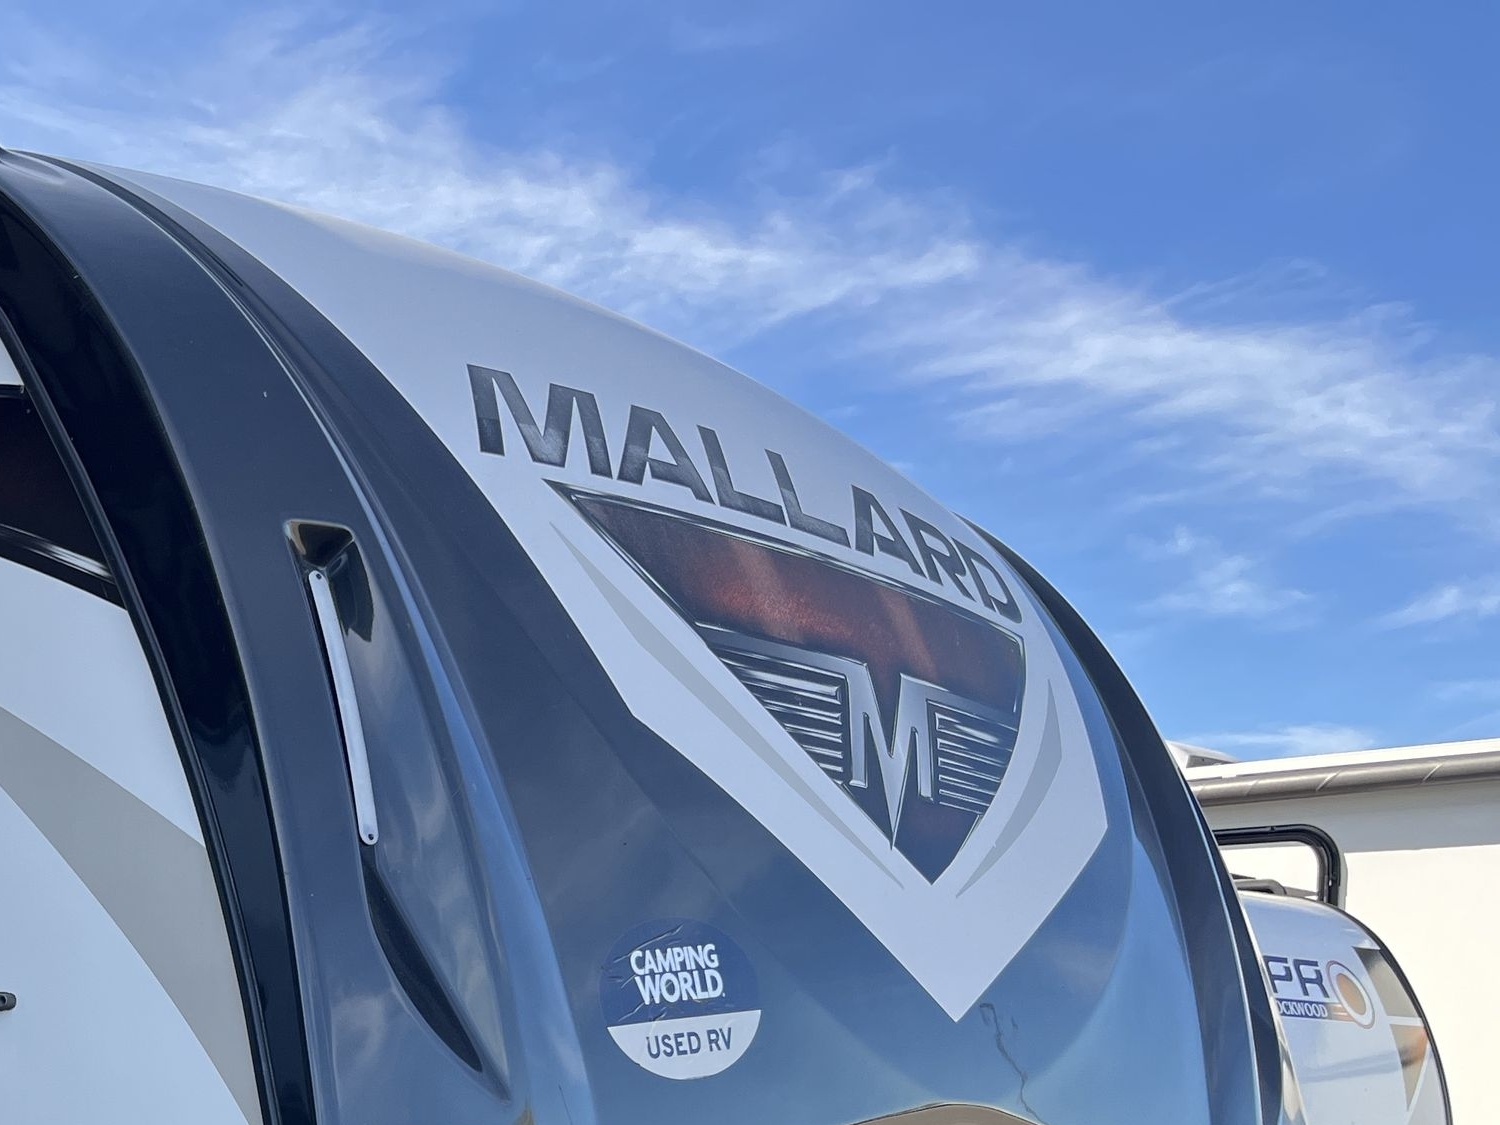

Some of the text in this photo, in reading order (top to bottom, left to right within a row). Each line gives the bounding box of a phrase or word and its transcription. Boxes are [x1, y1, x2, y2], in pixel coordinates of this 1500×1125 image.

[466, 363, 1024, 622] MALLARD
[629, 943, 720, 976] CAMPING
[646, 1026, 733, 1059] USED RV
